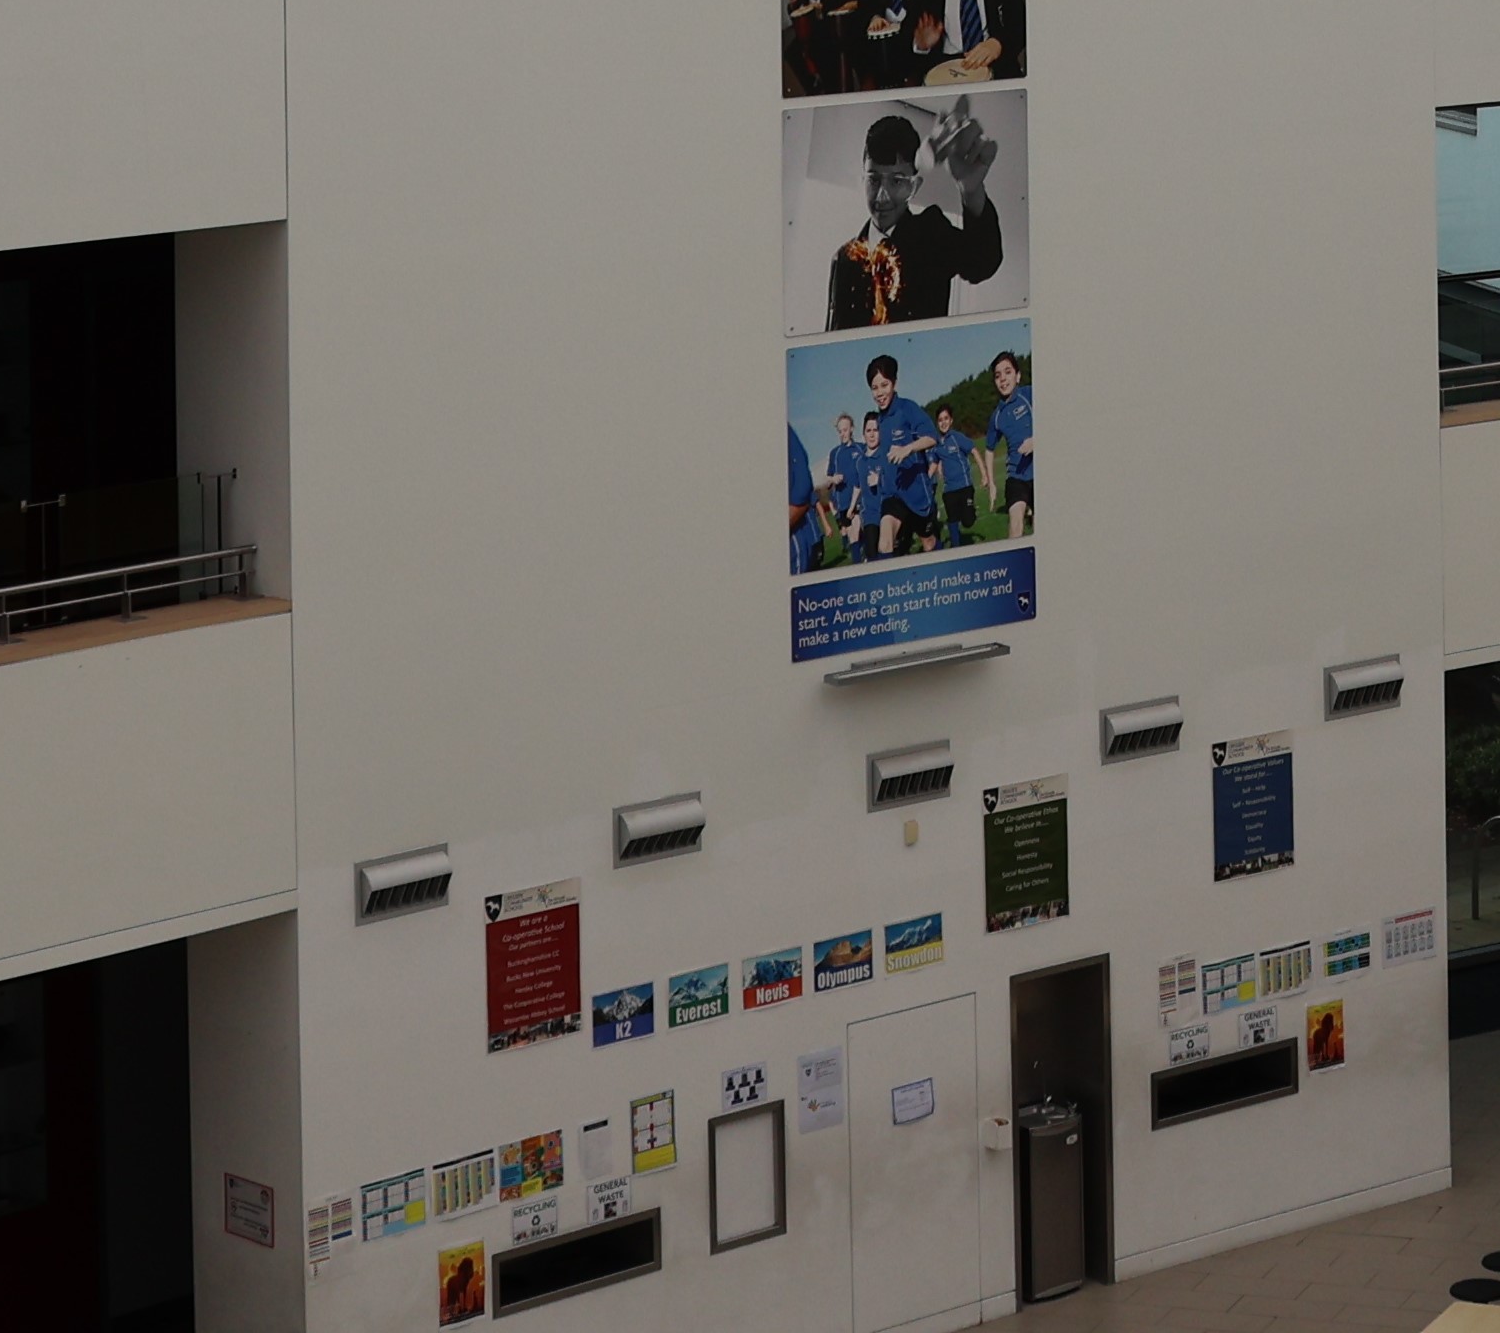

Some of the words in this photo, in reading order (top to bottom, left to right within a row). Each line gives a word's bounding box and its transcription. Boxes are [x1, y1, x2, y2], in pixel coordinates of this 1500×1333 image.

[798, 597, 844, 614] No-one
[848, 591, 867, 605] can
[870, 589, 884, 605] go
[888, 583, 913, 598] back
[916, 577, 938, 593] and
[941, 571, 971, 589] make
[974, 573, 980, 583] a
[984, 567, 1008, 581] new
[798, 615, 828, 631] start.
[833, 606, 877, 626] Anyone
[880, 602, 900, 616] can
[904, 597, 930, 612] start
[933, 590, 962, 608] from
[964, 587, 989, 601] now
[992, 579, 1012, 595] and
[798, 631, 830, 649] make
[832, 631, 840, 641] a
[842, 626, 867, 640] new
[870, 618, 910, 635] ending.
[886, 945, 943, 971] Snowdon
[817, 963, 871, 991] Olympus
[756, 983, 790, 1006] Nevis
[676, 1001, 722, 1025] Everest
[1248, 1019, 1270, 1030] WASTE
[615, 1020, 632, 1040] K2
[1171, 1025, 1208, 1041] RECYCLING
[594, 1178, 628, 1194] GENERAL
[598, 1190, 624, 1204] WASTE
[514, 1199, 556, 1217] RECYCLING
